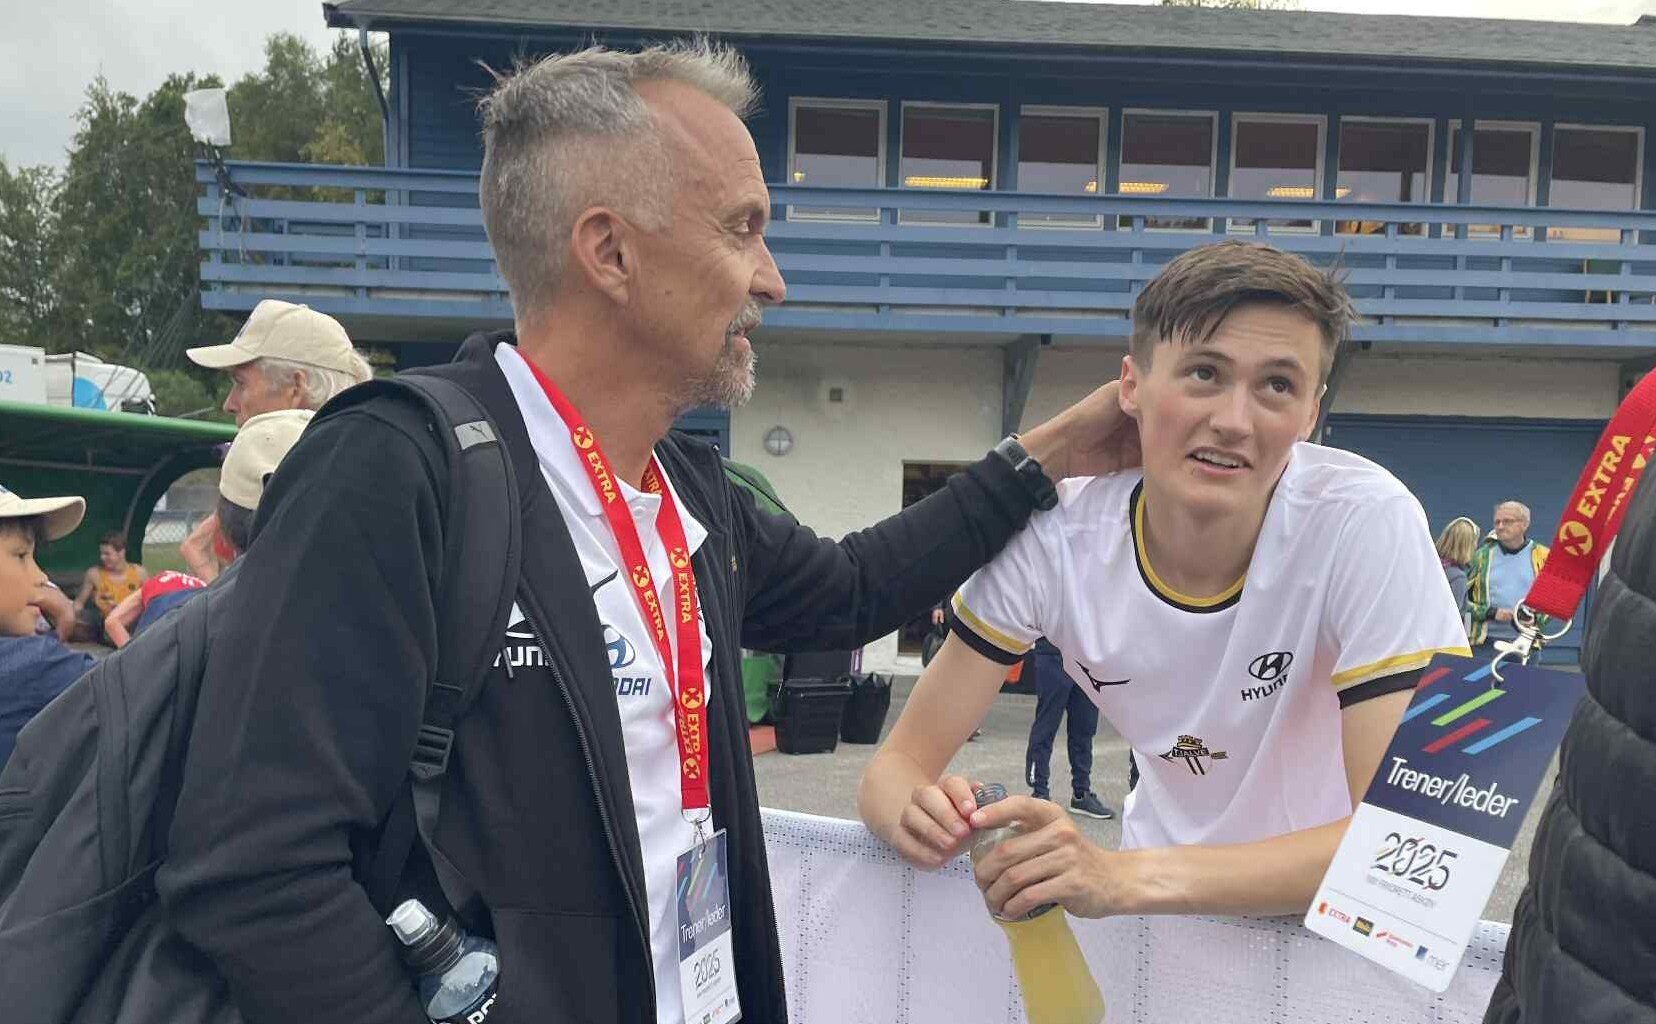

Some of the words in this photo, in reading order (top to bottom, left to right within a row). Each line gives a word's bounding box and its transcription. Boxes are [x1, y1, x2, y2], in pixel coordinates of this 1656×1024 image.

[587, 451, 616, 504] EXTRA
[1576, 435, 1631, 519] EXTRA
[645, 590, 664, 642] EXTRA
[677, 573, 692, 624] EXTRA
[687, 713, 701, 760] EXTR
[1386, 756, 1519, 818] Trener/leder
[1371, 832, 1457, 890] 2025
